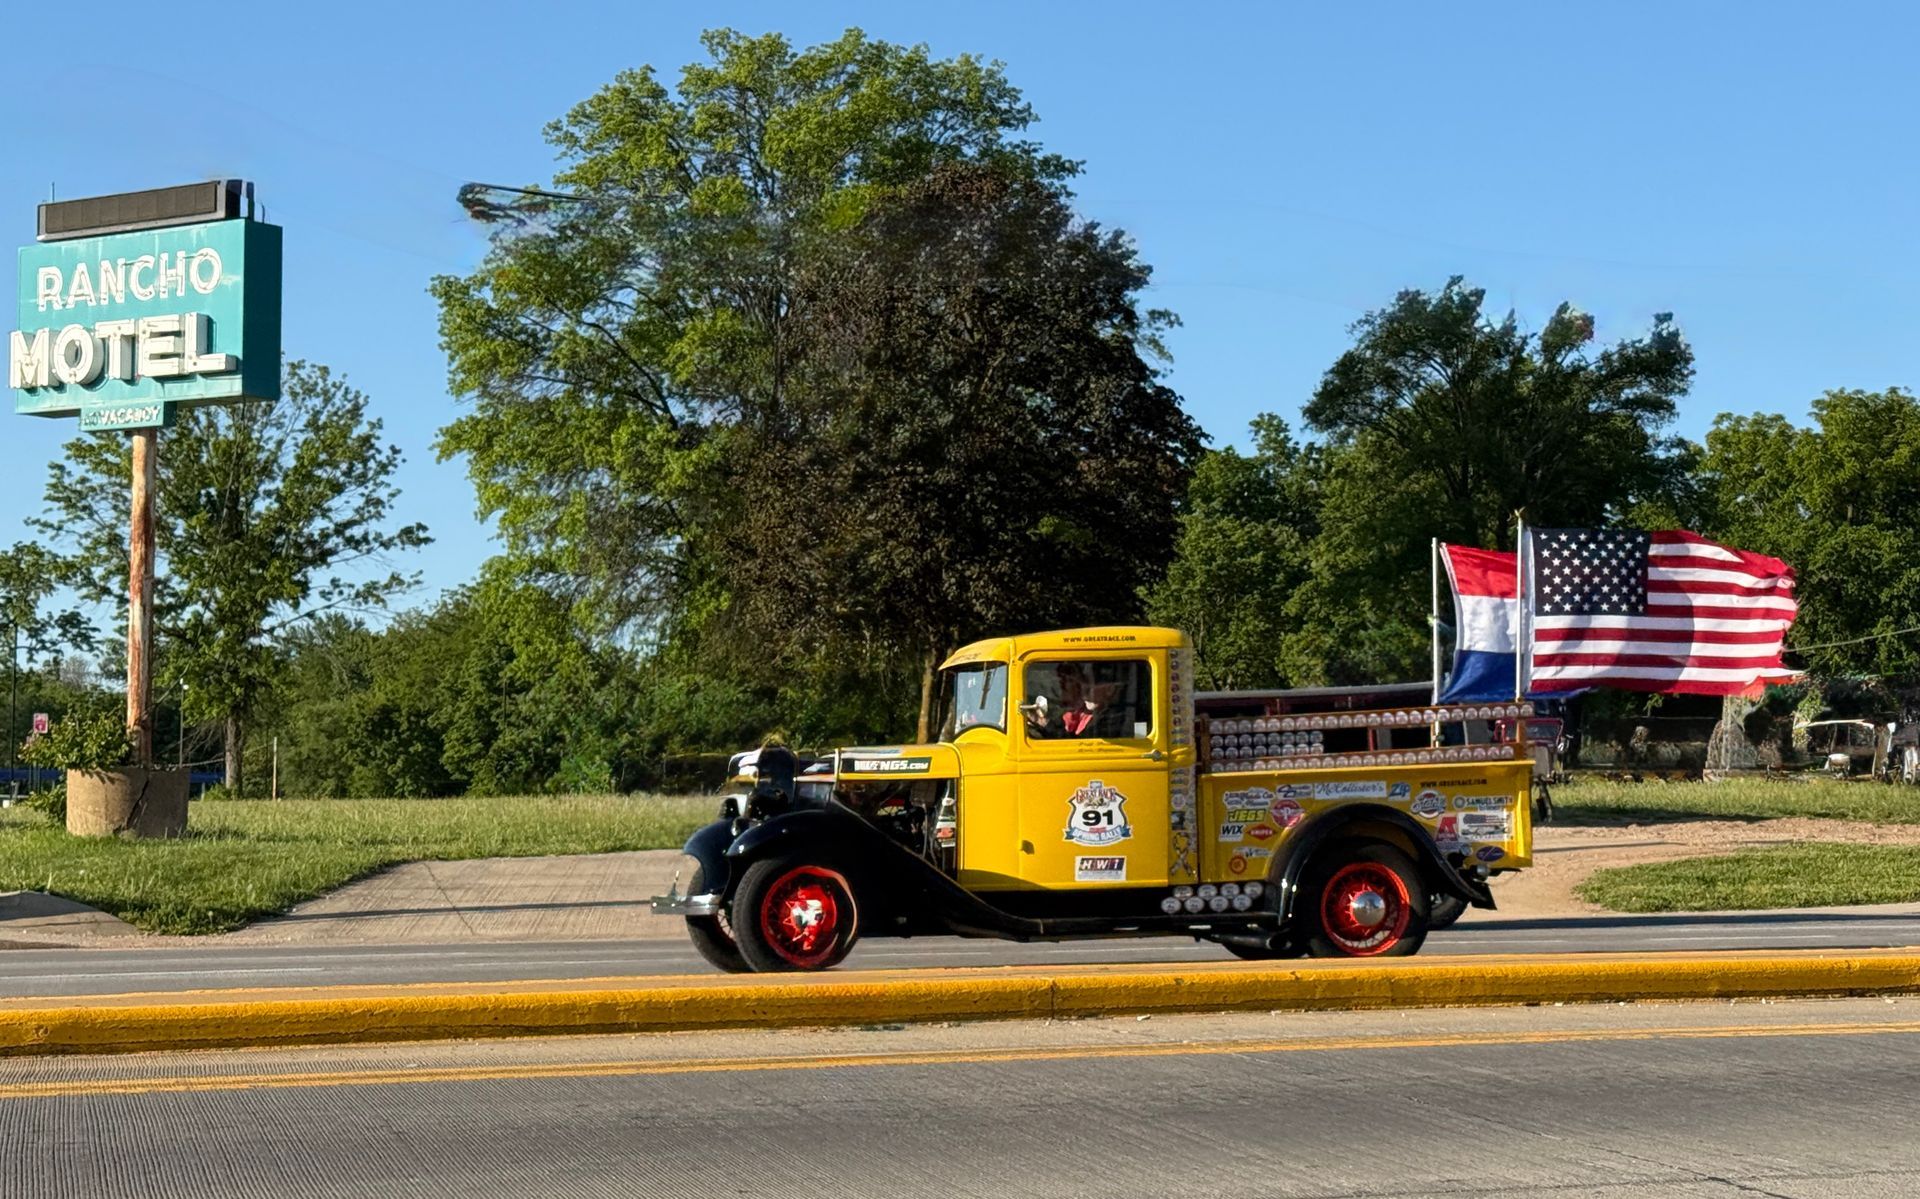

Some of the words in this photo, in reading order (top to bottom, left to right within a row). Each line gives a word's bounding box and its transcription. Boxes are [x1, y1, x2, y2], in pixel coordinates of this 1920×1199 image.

[37, 248, 222, 312] RANCHO
[9, 312, 237, 389] MOTEL
[1082, 809, 1114, 827] 91
[1230, 808, 1266, 822] JEGS
[1222, 825, 1244, 835] WIX
